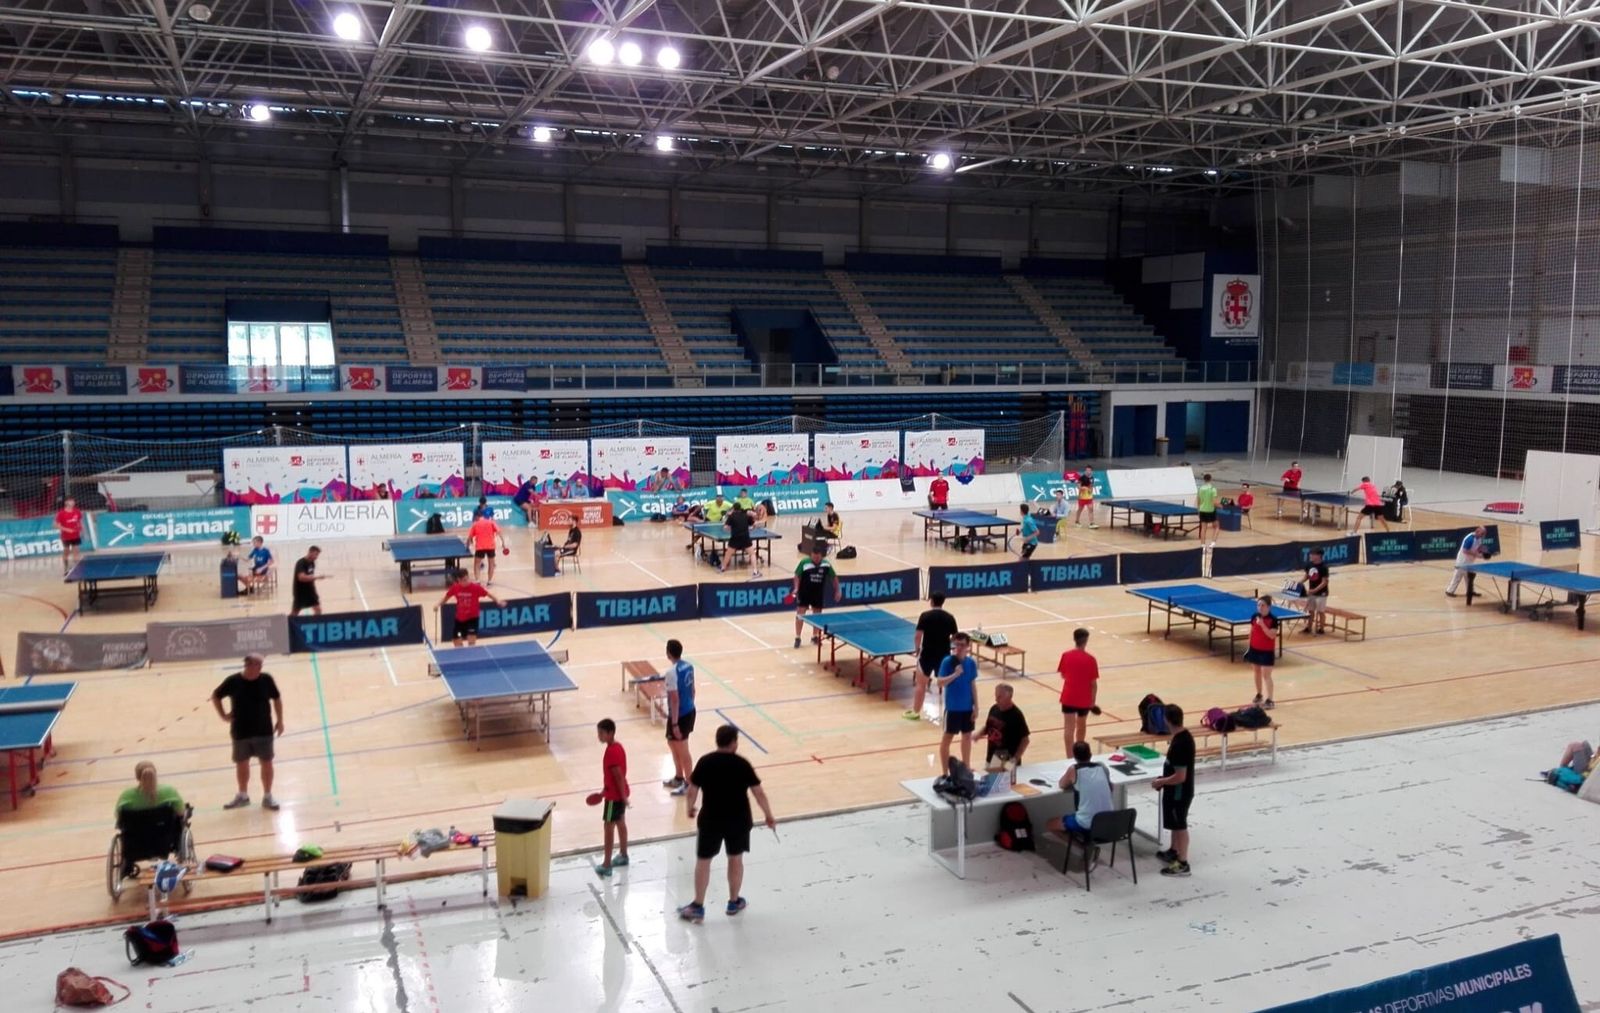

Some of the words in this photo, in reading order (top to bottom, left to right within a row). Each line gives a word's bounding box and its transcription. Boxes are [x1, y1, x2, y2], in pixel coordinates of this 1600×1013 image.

[298, 502, 390, 520] ALMERÍA
[142, 518, 234, 541] cajamar
[297, 521, 345, 533] CIUDAD
[1302, 544, 1348, 562] THAR
[945, 570, 1012, 590] TIBHAR
[1041, 563, 1102, 582] TIBHAR
[479, 604, 551, 630] IBHAR
[596, 595, 677, 618] TIBHAR
[301, 617, 398, 644] TIBHAR
[1454, 962, 1533, 998] MUNICIPALES
